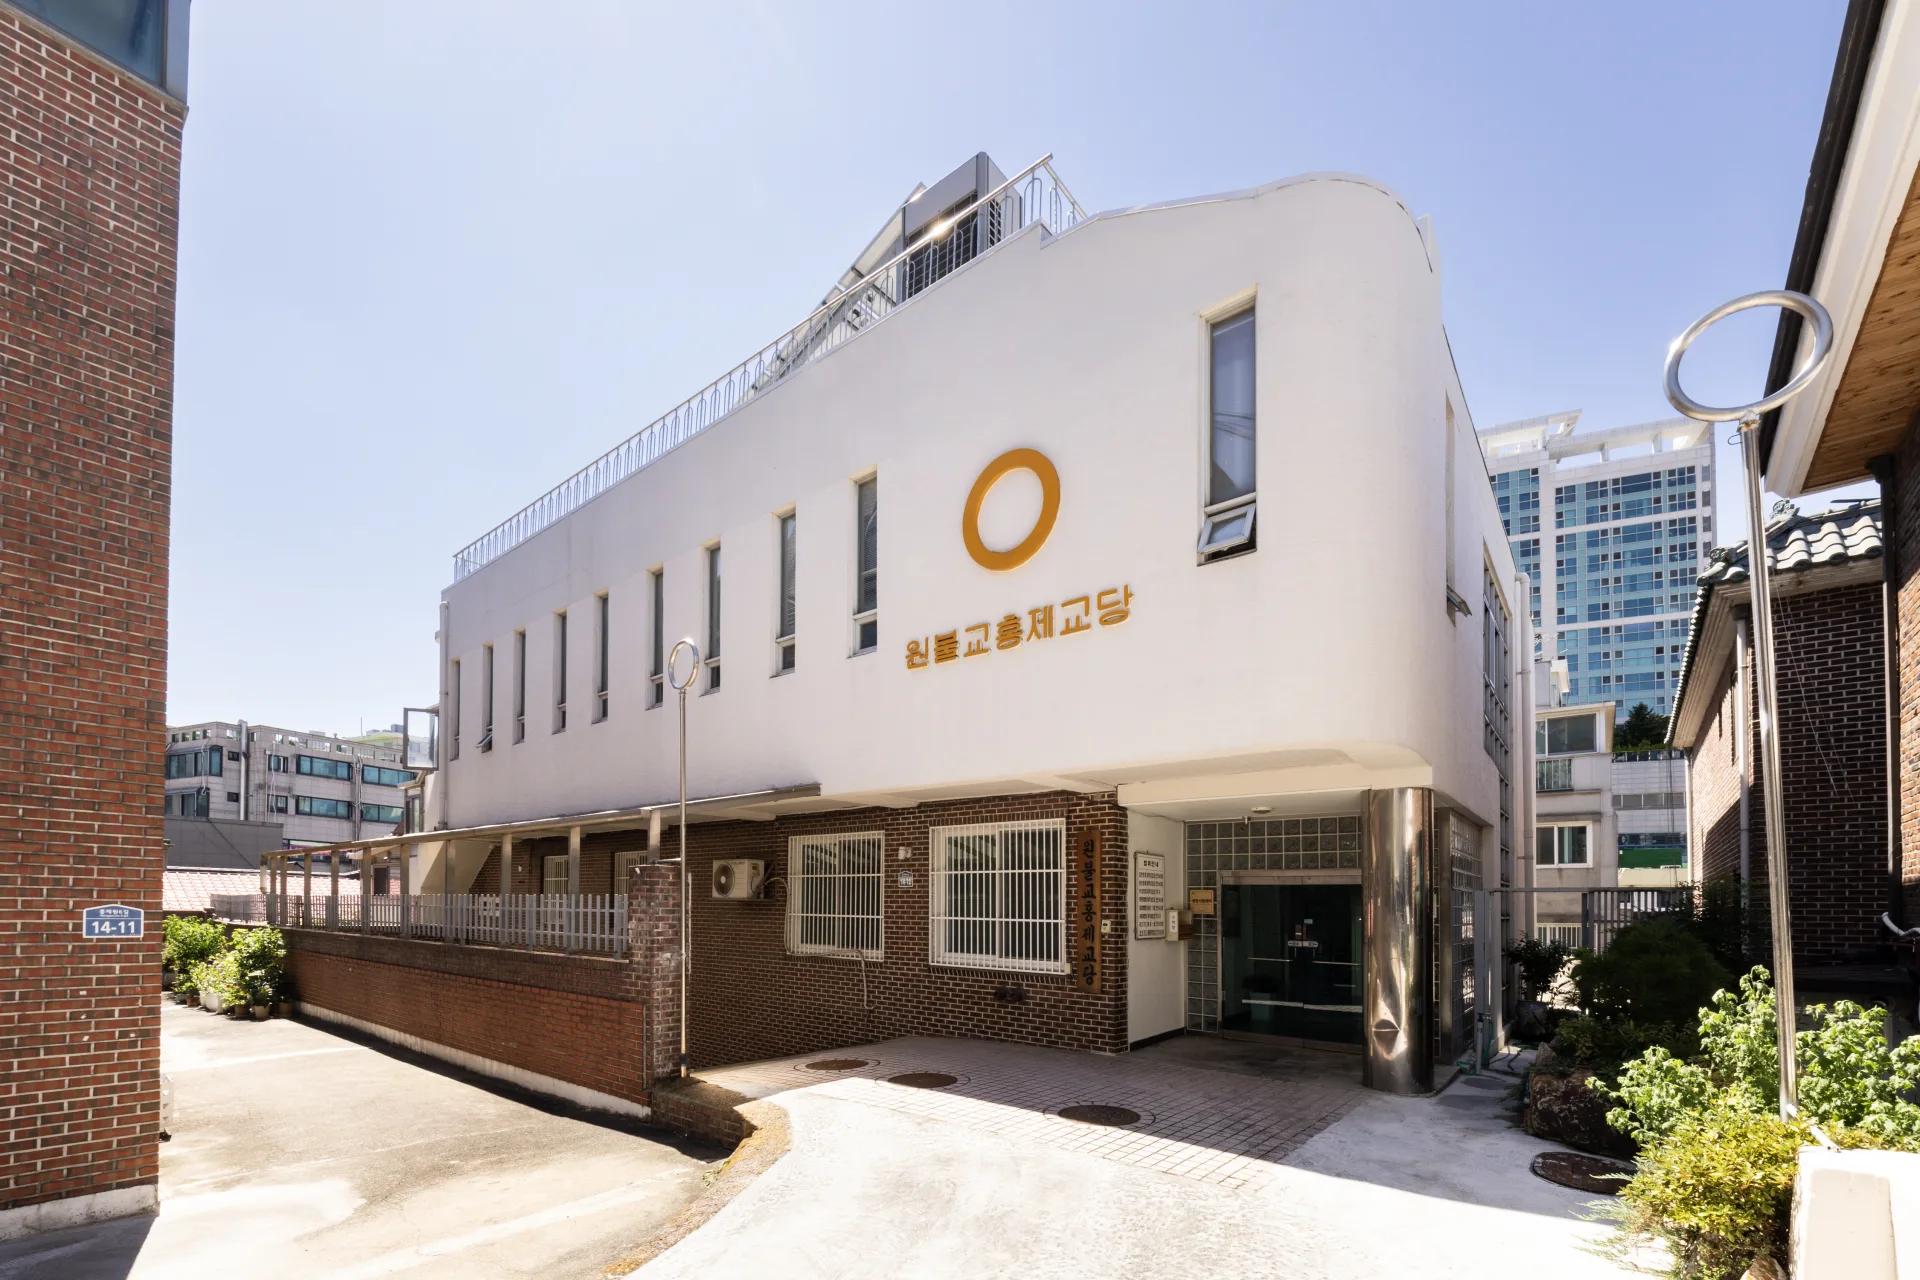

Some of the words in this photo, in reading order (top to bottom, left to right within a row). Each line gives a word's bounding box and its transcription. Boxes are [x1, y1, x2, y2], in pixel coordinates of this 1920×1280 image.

[905, 584, 1134, 669] 원불교홍제교당
[92, 921, 135, 934] 14-11
[1081, 839, 1097, 985] 원불교홍제교당
